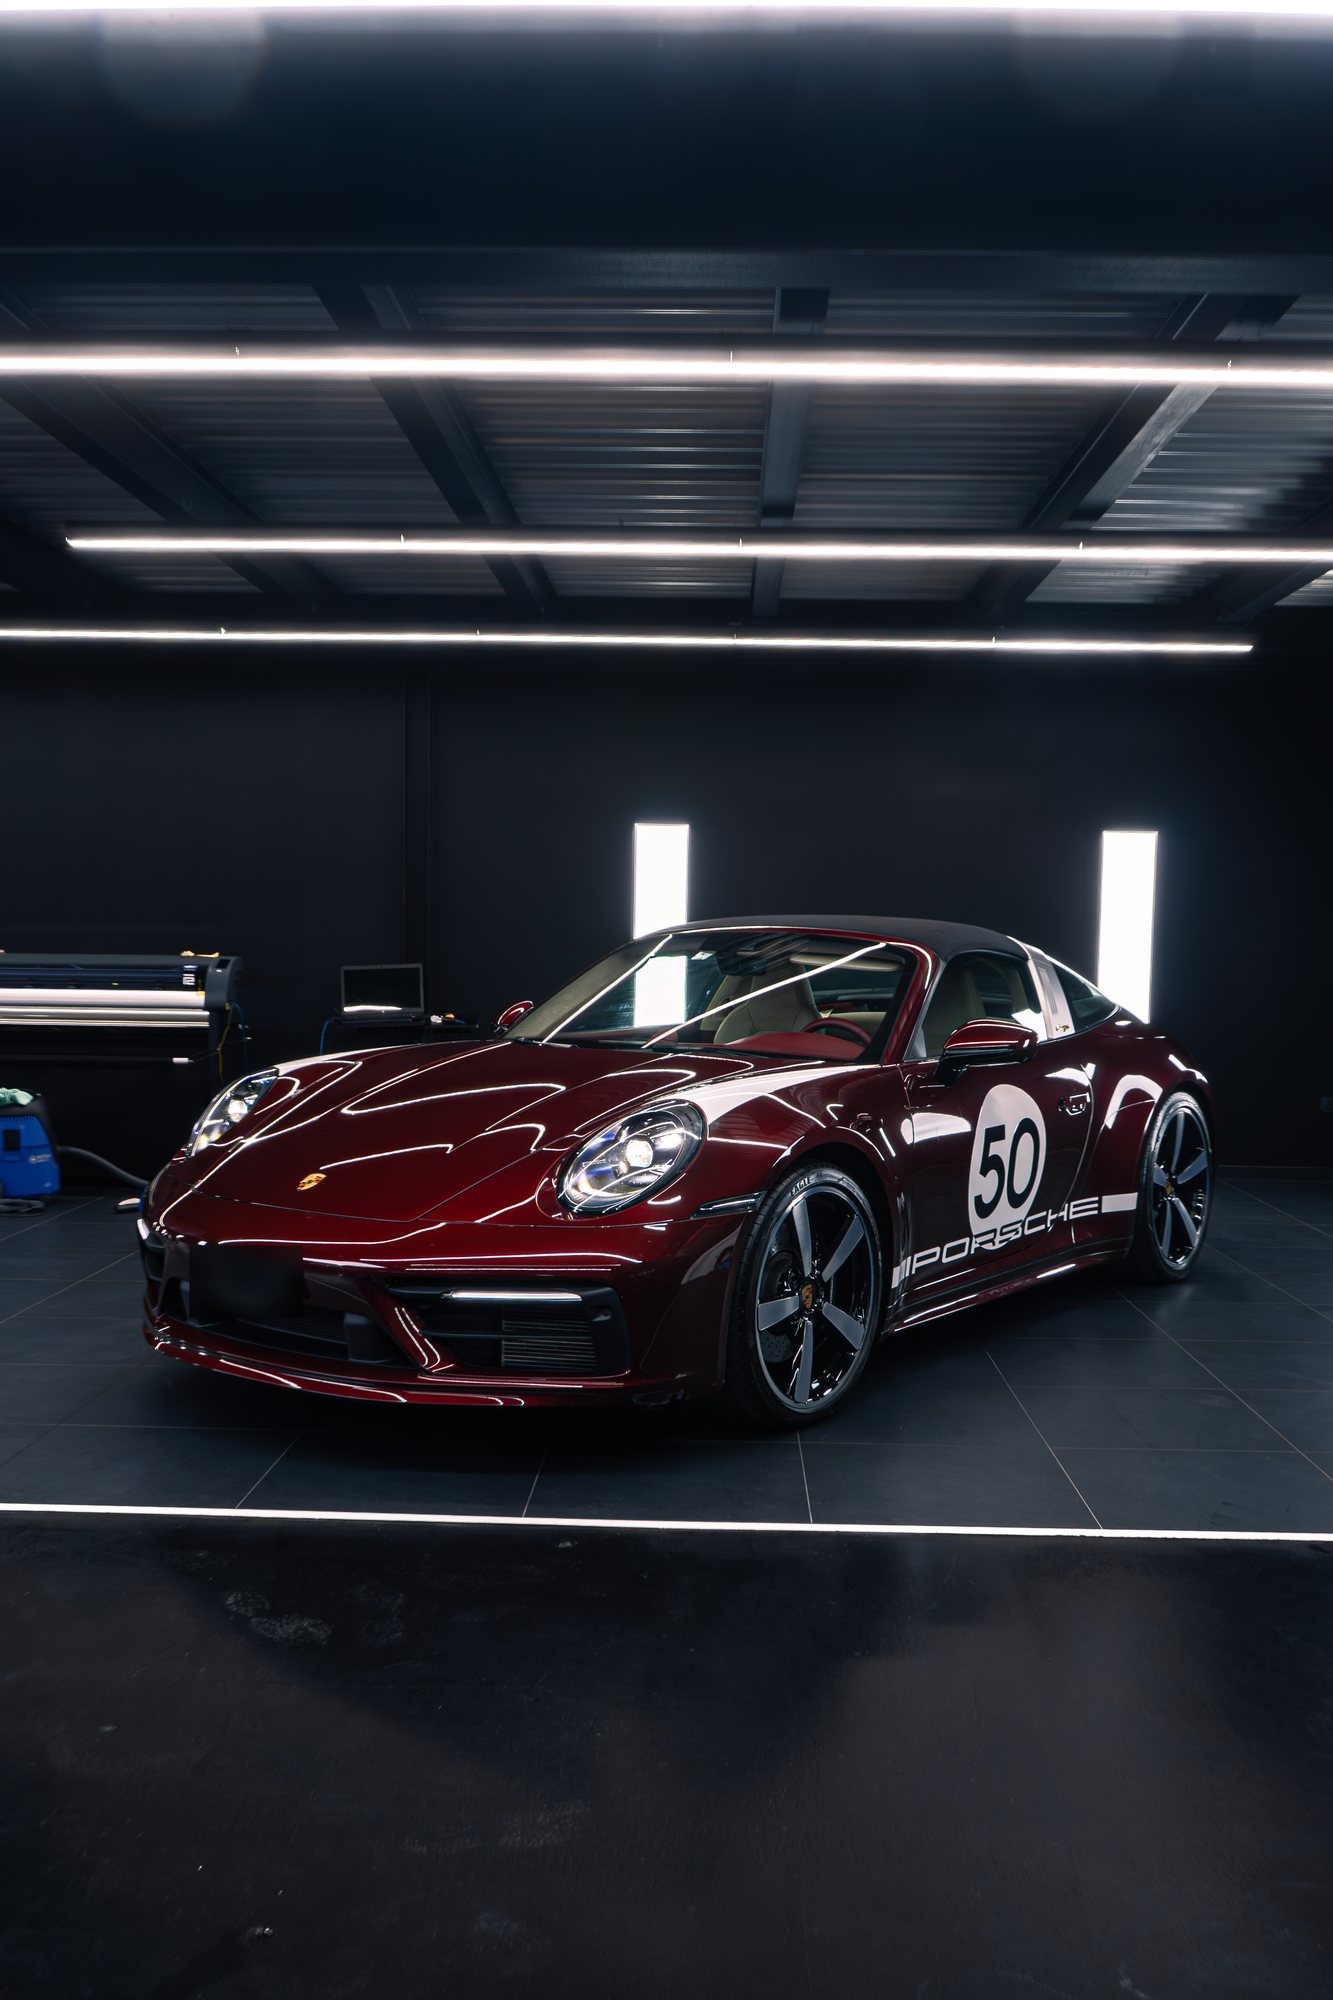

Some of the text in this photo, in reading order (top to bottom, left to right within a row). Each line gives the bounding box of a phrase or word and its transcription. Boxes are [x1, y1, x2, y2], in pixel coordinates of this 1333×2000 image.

[789, 1176, 812, 1196] EAGLE
[973, 1117, 1040, 1219] 50
[911, 1196, 1099, 1275] PORSCHE
